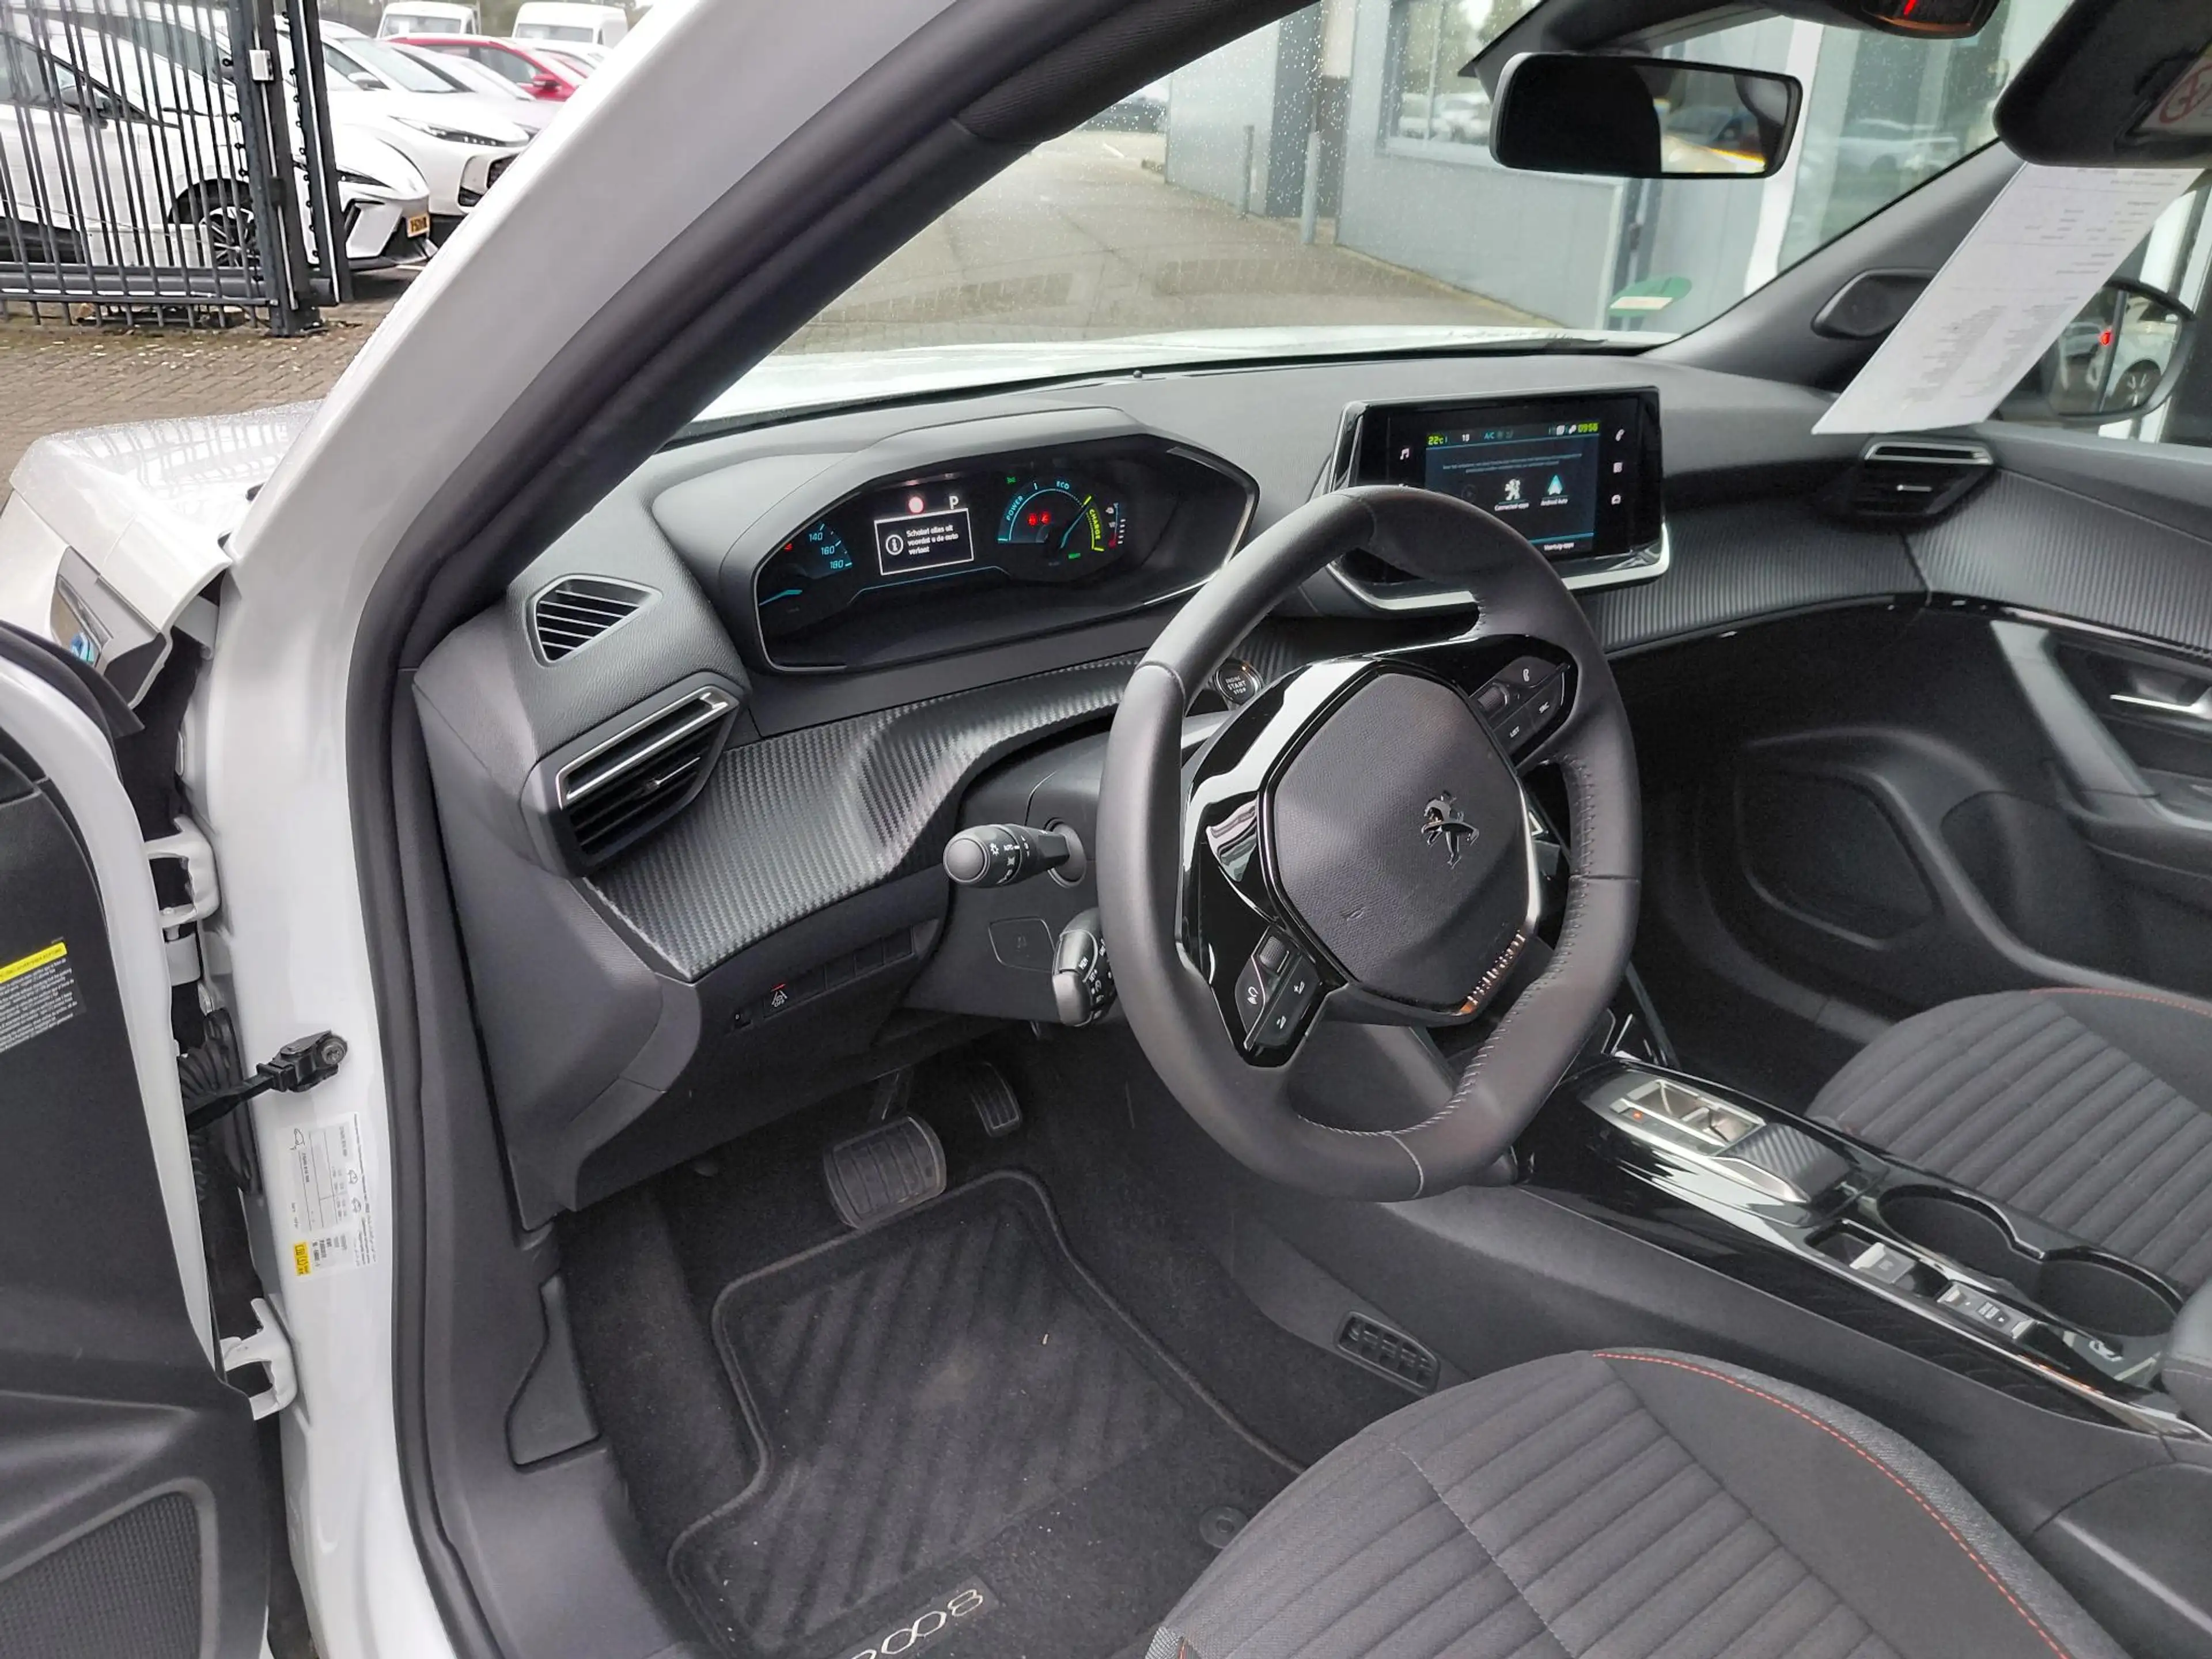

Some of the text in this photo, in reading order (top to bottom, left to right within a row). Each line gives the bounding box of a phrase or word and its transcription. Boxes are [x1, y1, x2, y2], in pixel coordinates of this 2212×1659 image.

[1056, 480, 1070, 490] ECO
[949, 495, 959, 510] P
[1006, 495, 1024, 521] POWER
[1089, 509, 1102, 540] CHARGE
[808, 532, 823, 542] 140
[821, 546, 835, 556] 160
[830, 559, 844, 570] 180
